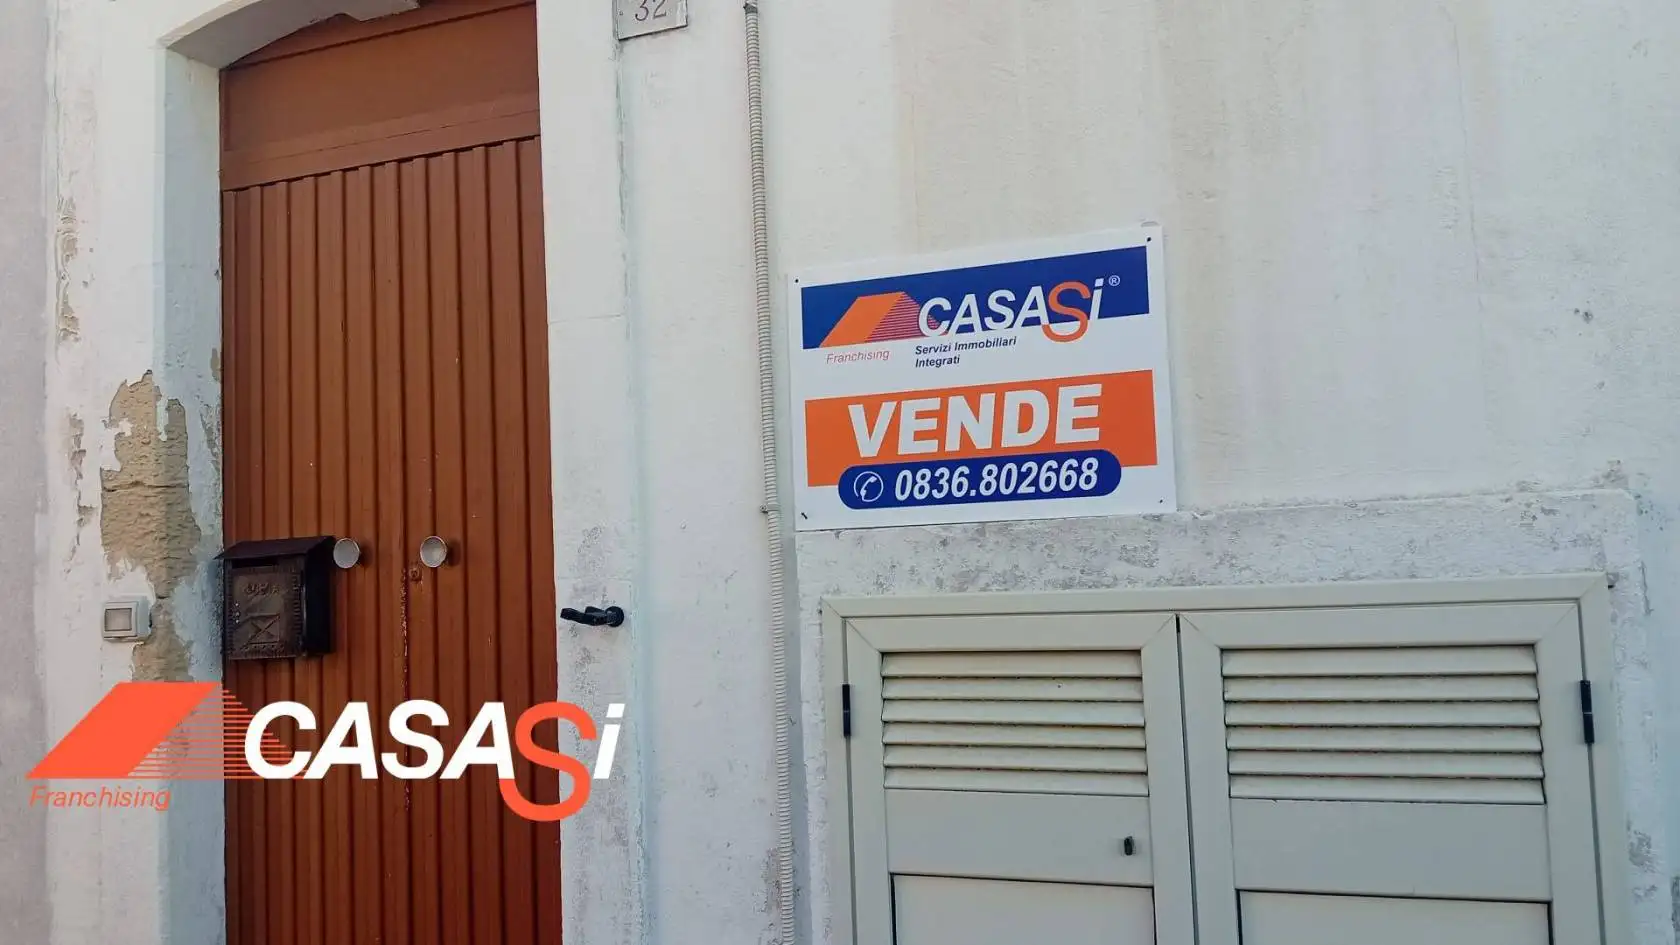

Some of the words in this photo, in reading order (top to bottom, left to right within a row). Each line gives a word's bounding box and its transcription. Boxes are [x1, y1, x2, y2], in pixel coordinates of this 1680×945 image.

[635, 0, 668, 21] 32
[915, 343, 953, 355] Servizi
[954, 336, 1017, 352] Immobiliari
[826, 348, 890, 364] Franchising
[915, 354, 961, 368] Integrati
[848, 383, 1102, 457] VENDE
[894, 457, 1099, 501] 0836.802668
